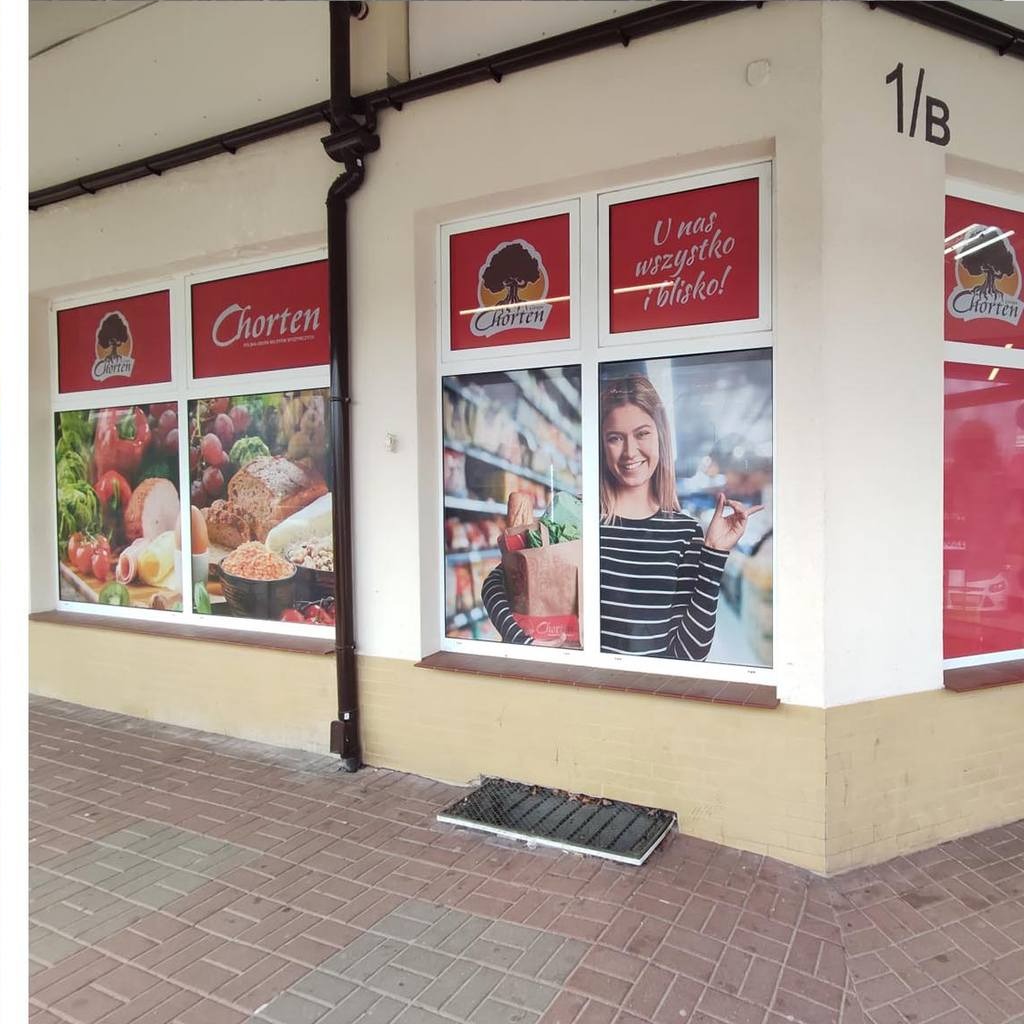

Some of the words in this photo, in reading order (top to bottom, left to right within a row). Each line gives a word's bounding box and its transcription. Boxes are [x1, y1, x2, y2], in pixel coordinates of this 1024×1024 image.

[885, 62, 951, 147] 1/B
[653, 217, 672, 246] U
[677, 212, 717, 239] nas
[635, 228, 735, 279] wszystko
[643, 287, 652, 311] i
[657, 265, 732, 307] blisko!
[952, 289, 1018, 318] Chorten
[212, 303, 320, 347] Chorten
[475, 307, 544, 331] Chorten
[94, 360, 131, 377] Chorten
